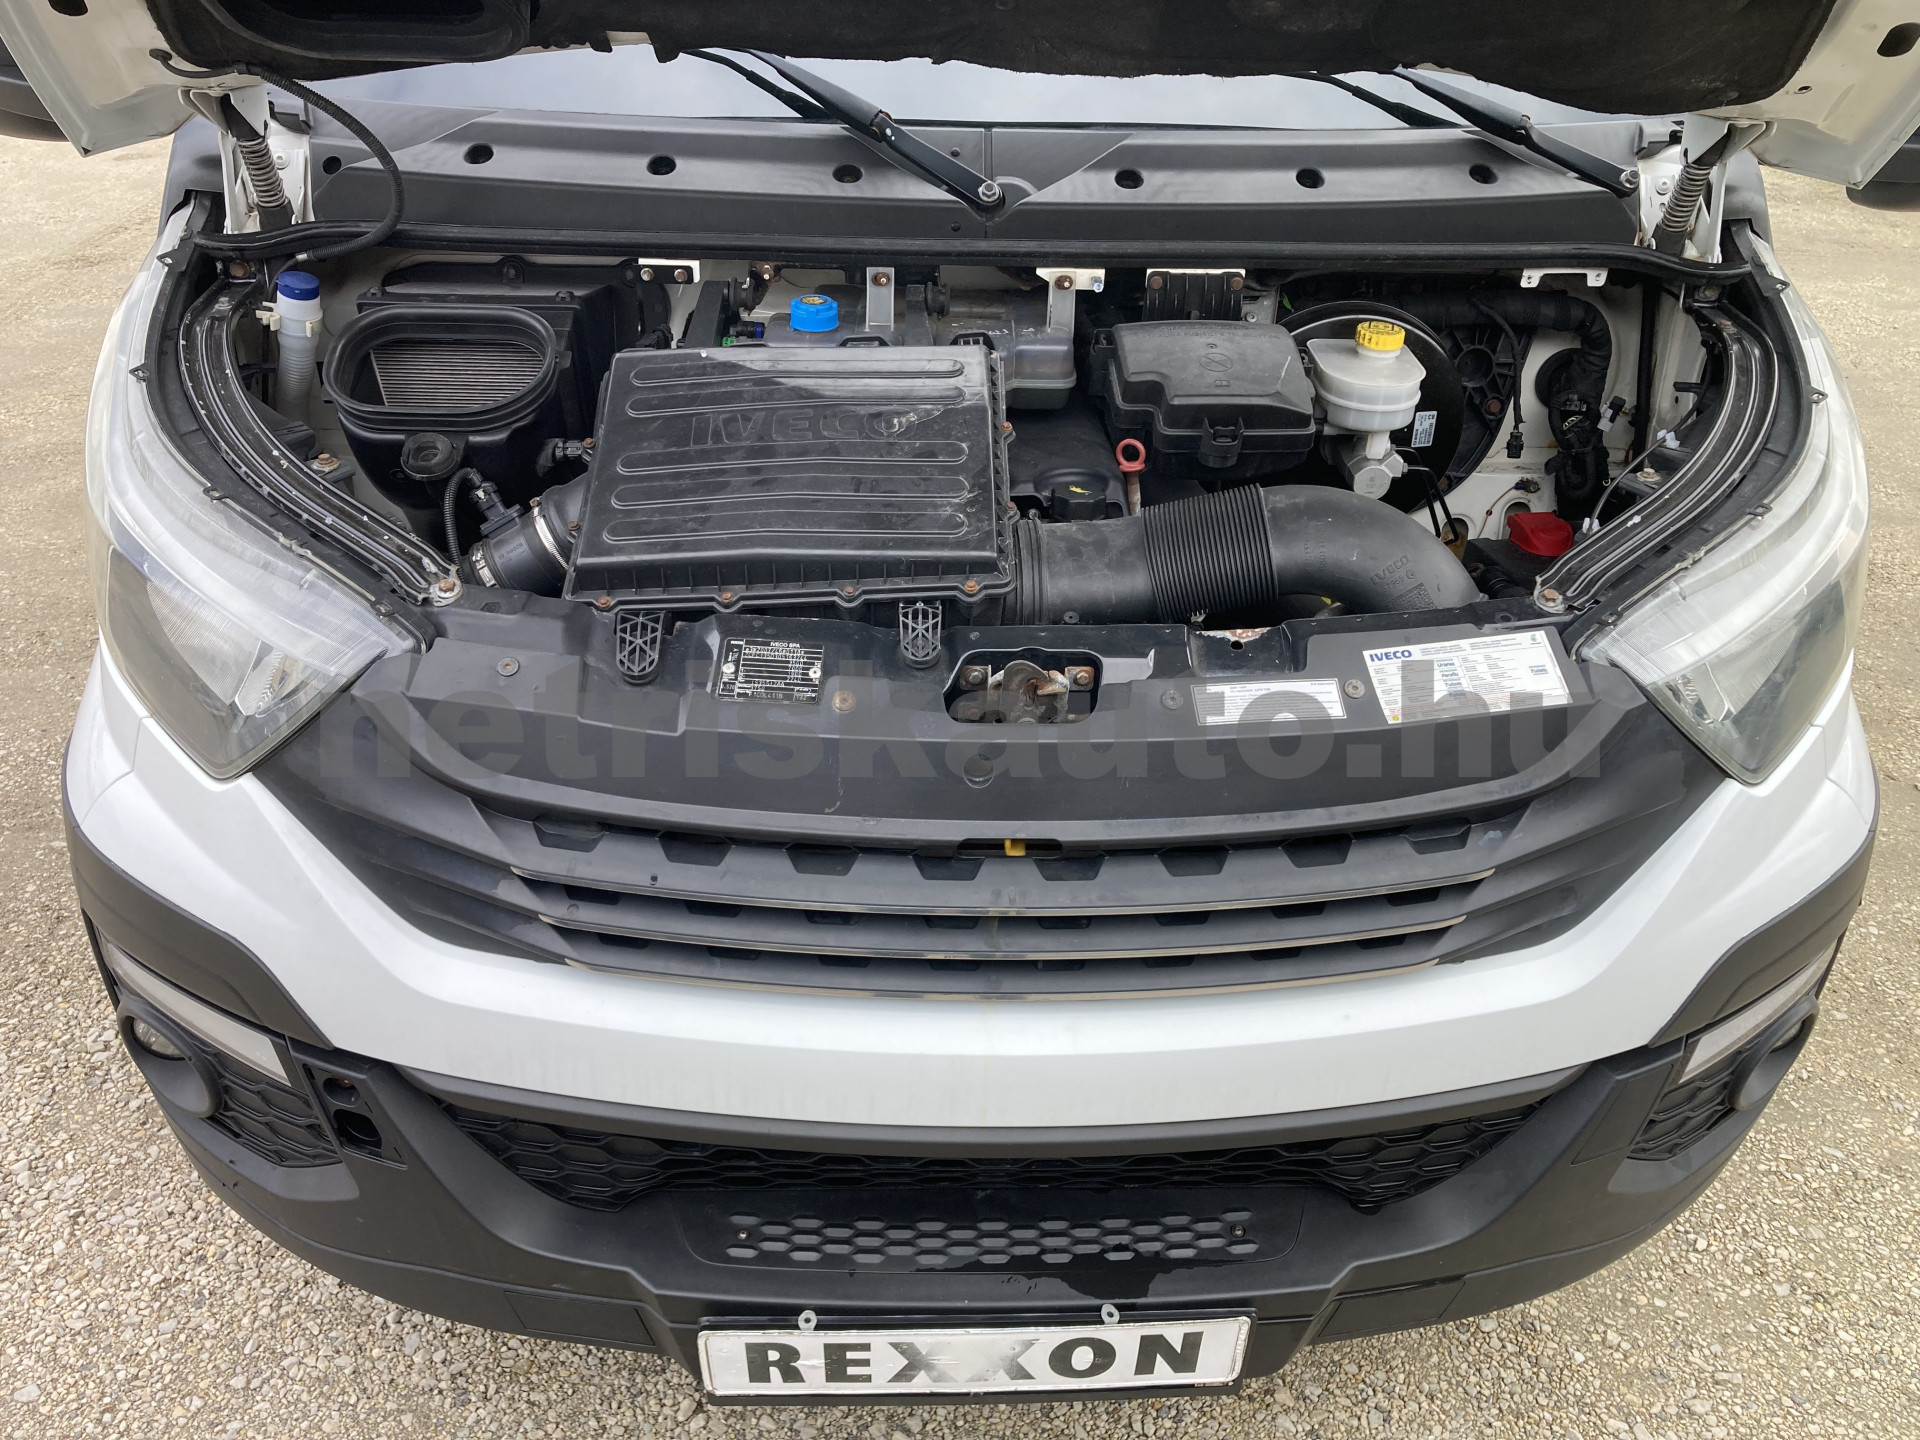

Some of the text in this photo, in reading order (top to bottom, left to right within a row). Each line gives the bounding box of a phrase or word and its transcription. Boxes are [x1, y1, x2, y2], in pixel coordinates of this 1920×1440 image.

[690, 407, 917, 447] IVECO
[1369, 649, 1412, 662] IVECO
[745, 1331, 1205, 1384] REXXON
